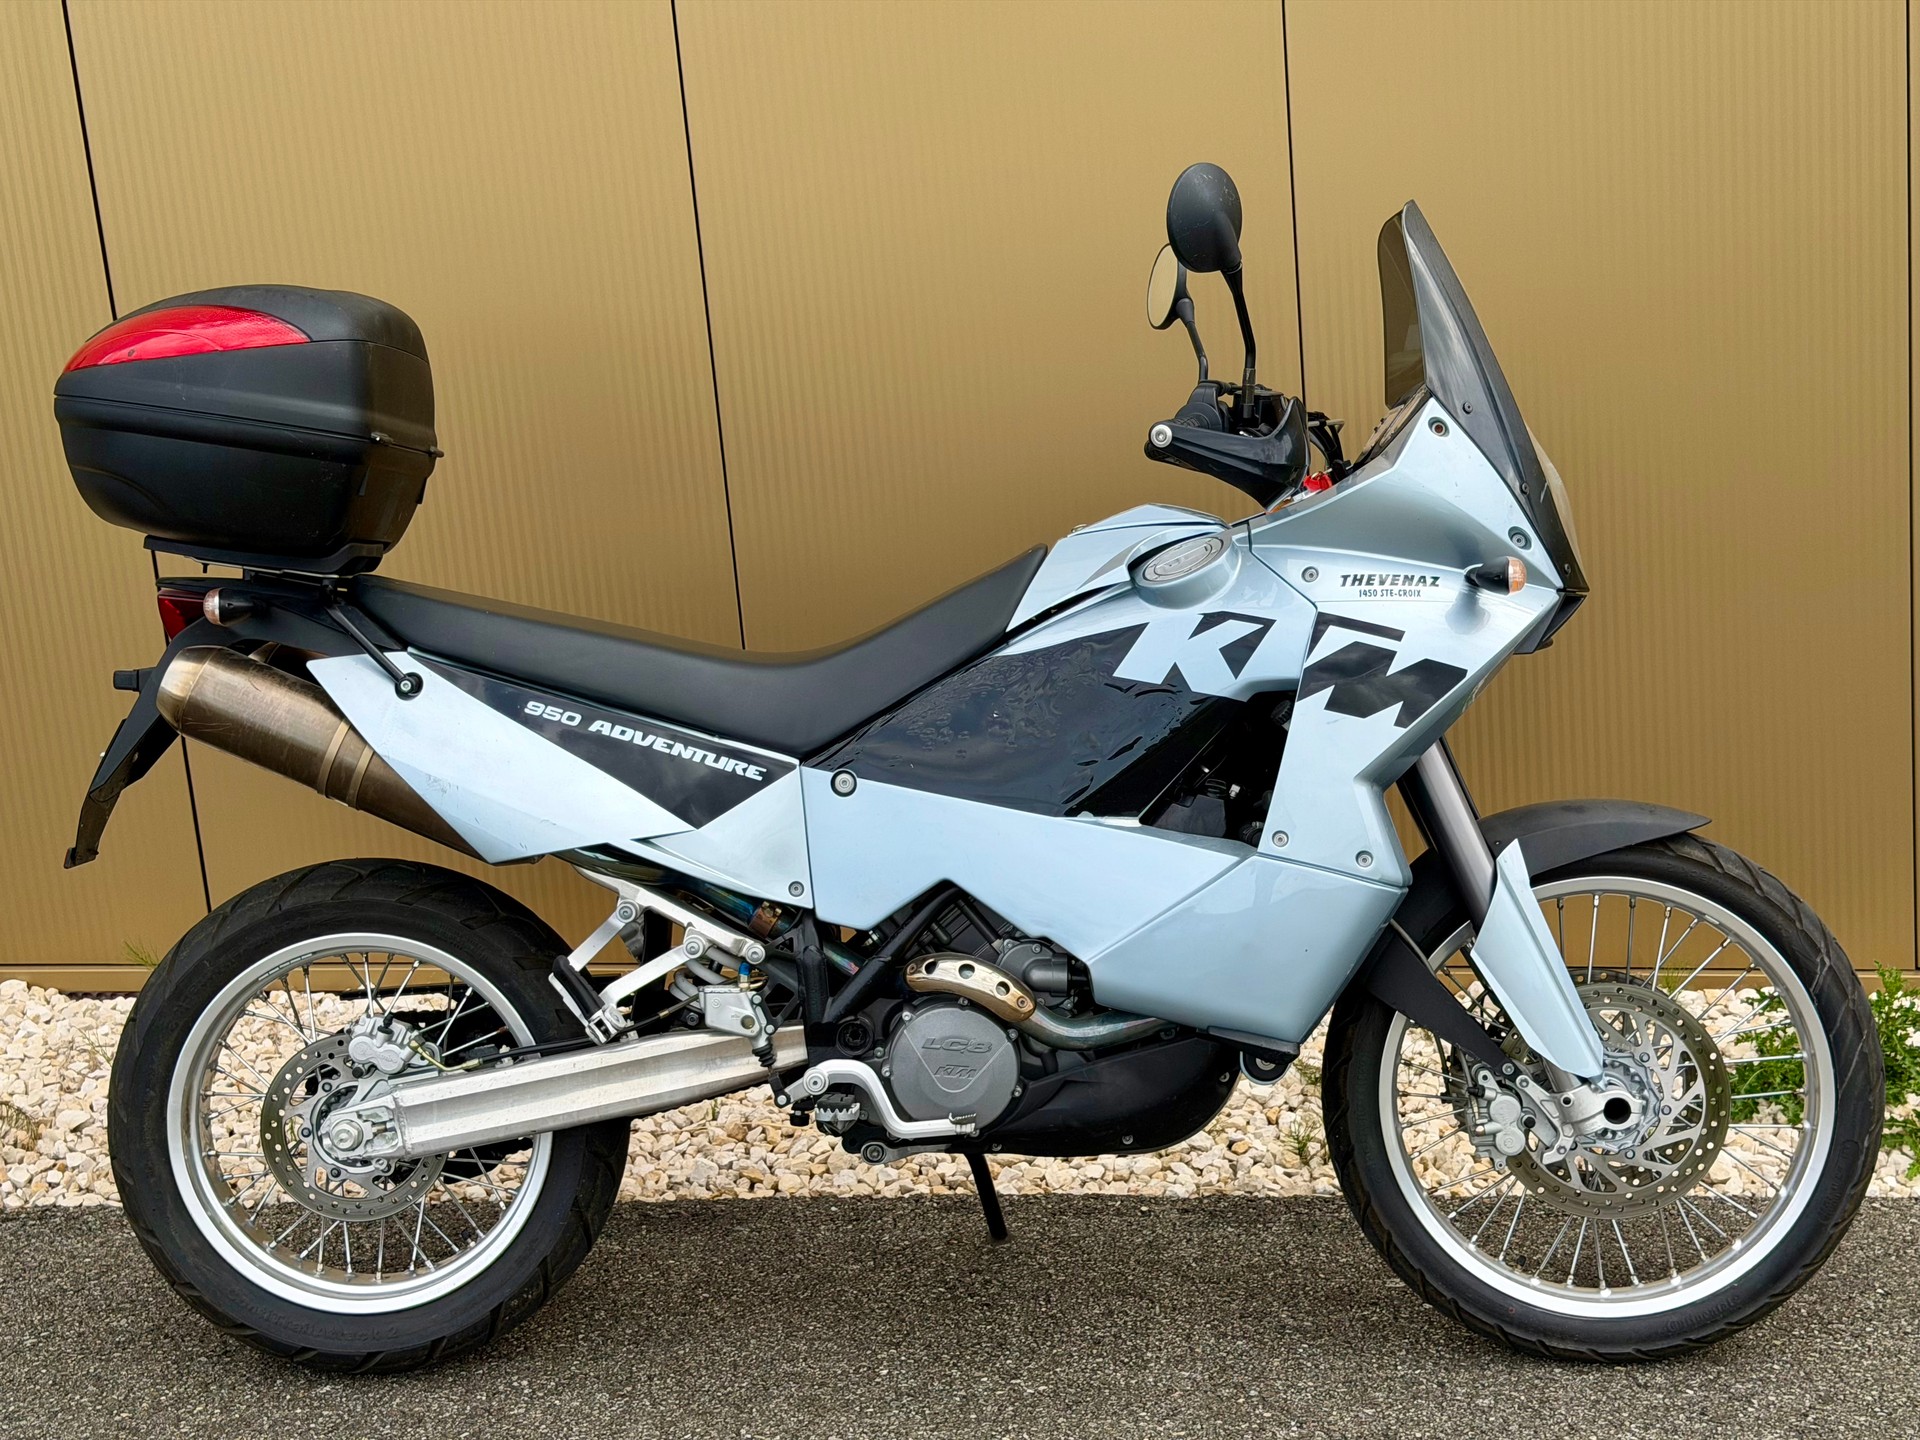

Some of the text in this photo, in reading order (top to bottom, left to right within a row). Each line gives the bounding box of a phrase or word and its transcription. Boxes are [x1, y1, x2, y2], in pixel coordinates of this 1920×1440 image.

[1340, 573, 1441, 588] THEVENAZ
[1358, 588, 1422, 598] 1450 STE-CROIX
[1112, 610, 1468, 729] KTM
[524, 700, 768, 781] 950 ADVENTURE
[922, 1036, 992, 1054] LC8
[934, 1064, 978, 1080] KTM
